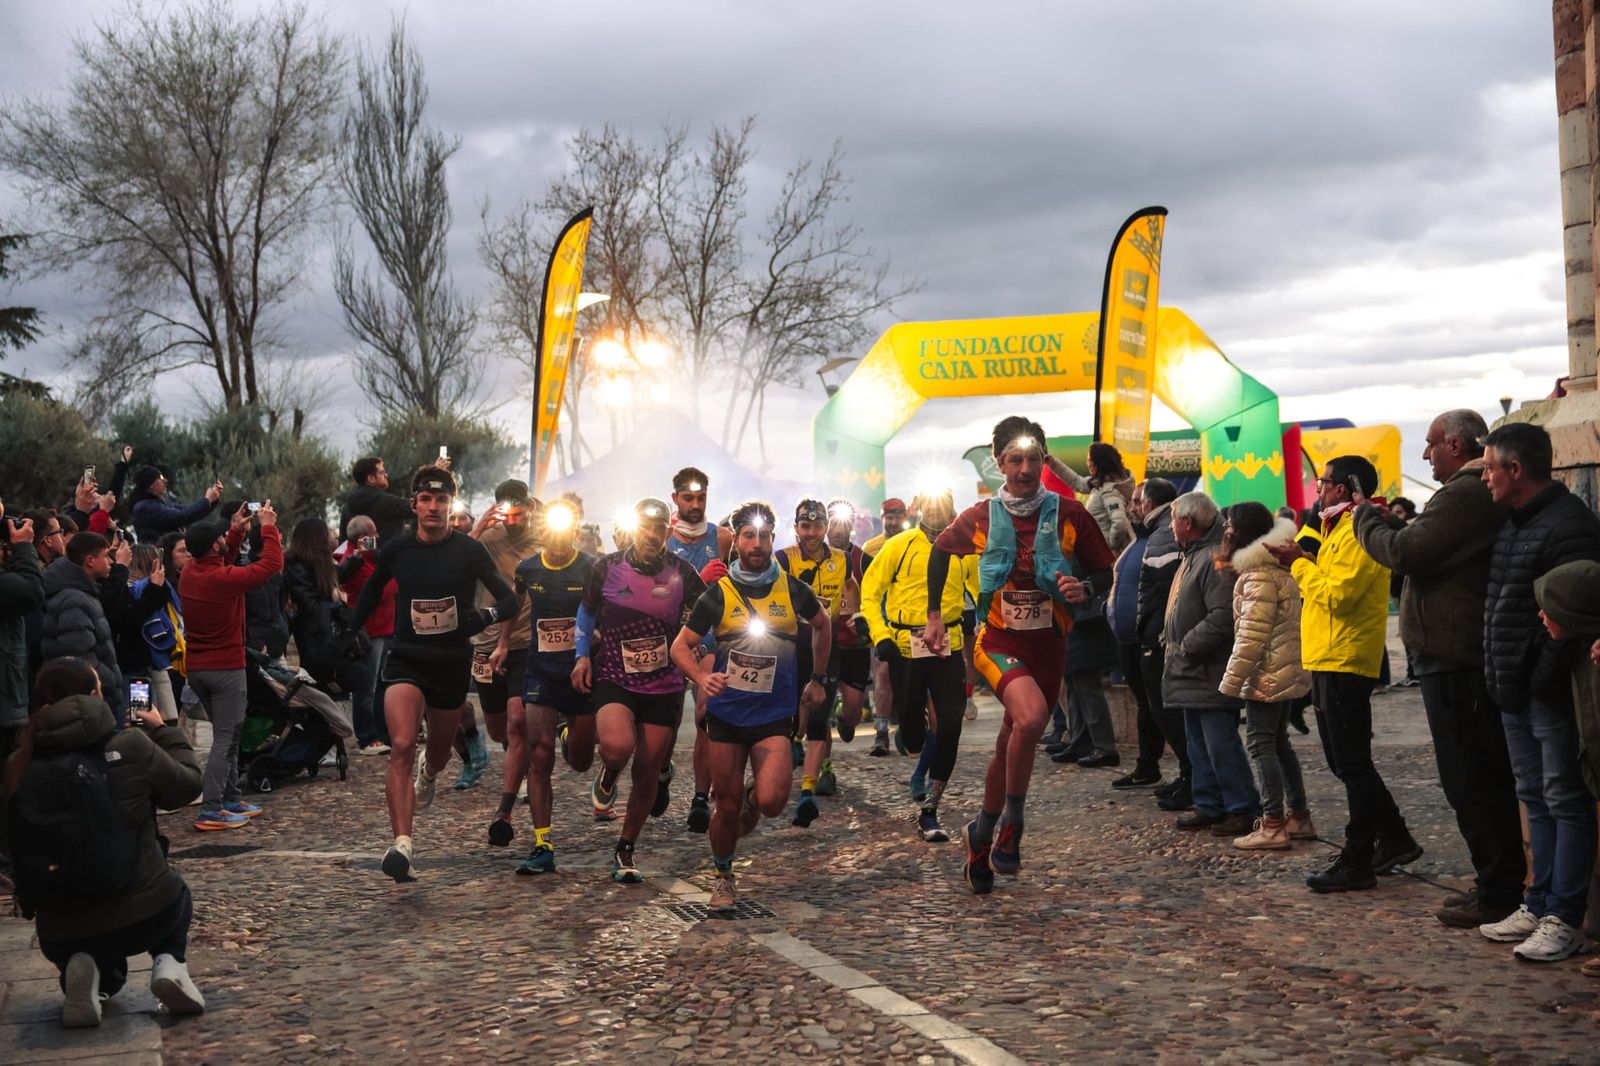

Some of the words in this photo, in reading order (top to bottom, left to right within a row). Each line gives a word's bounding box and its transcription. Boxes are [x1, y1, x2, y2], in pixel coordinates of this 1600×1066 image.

[919, 333, 1064, 357] FUNDACION
[919, 360, 978, 380] CAJA
[983, 356, 1067, 378] RURAL
[431, 614, 438, 626] 1
[1014, 606, 1041, 620] 278
[547, 631, 570, 644] 252
[634, 651, 658, 665] 223
[740, 669, 759, 684] 42
